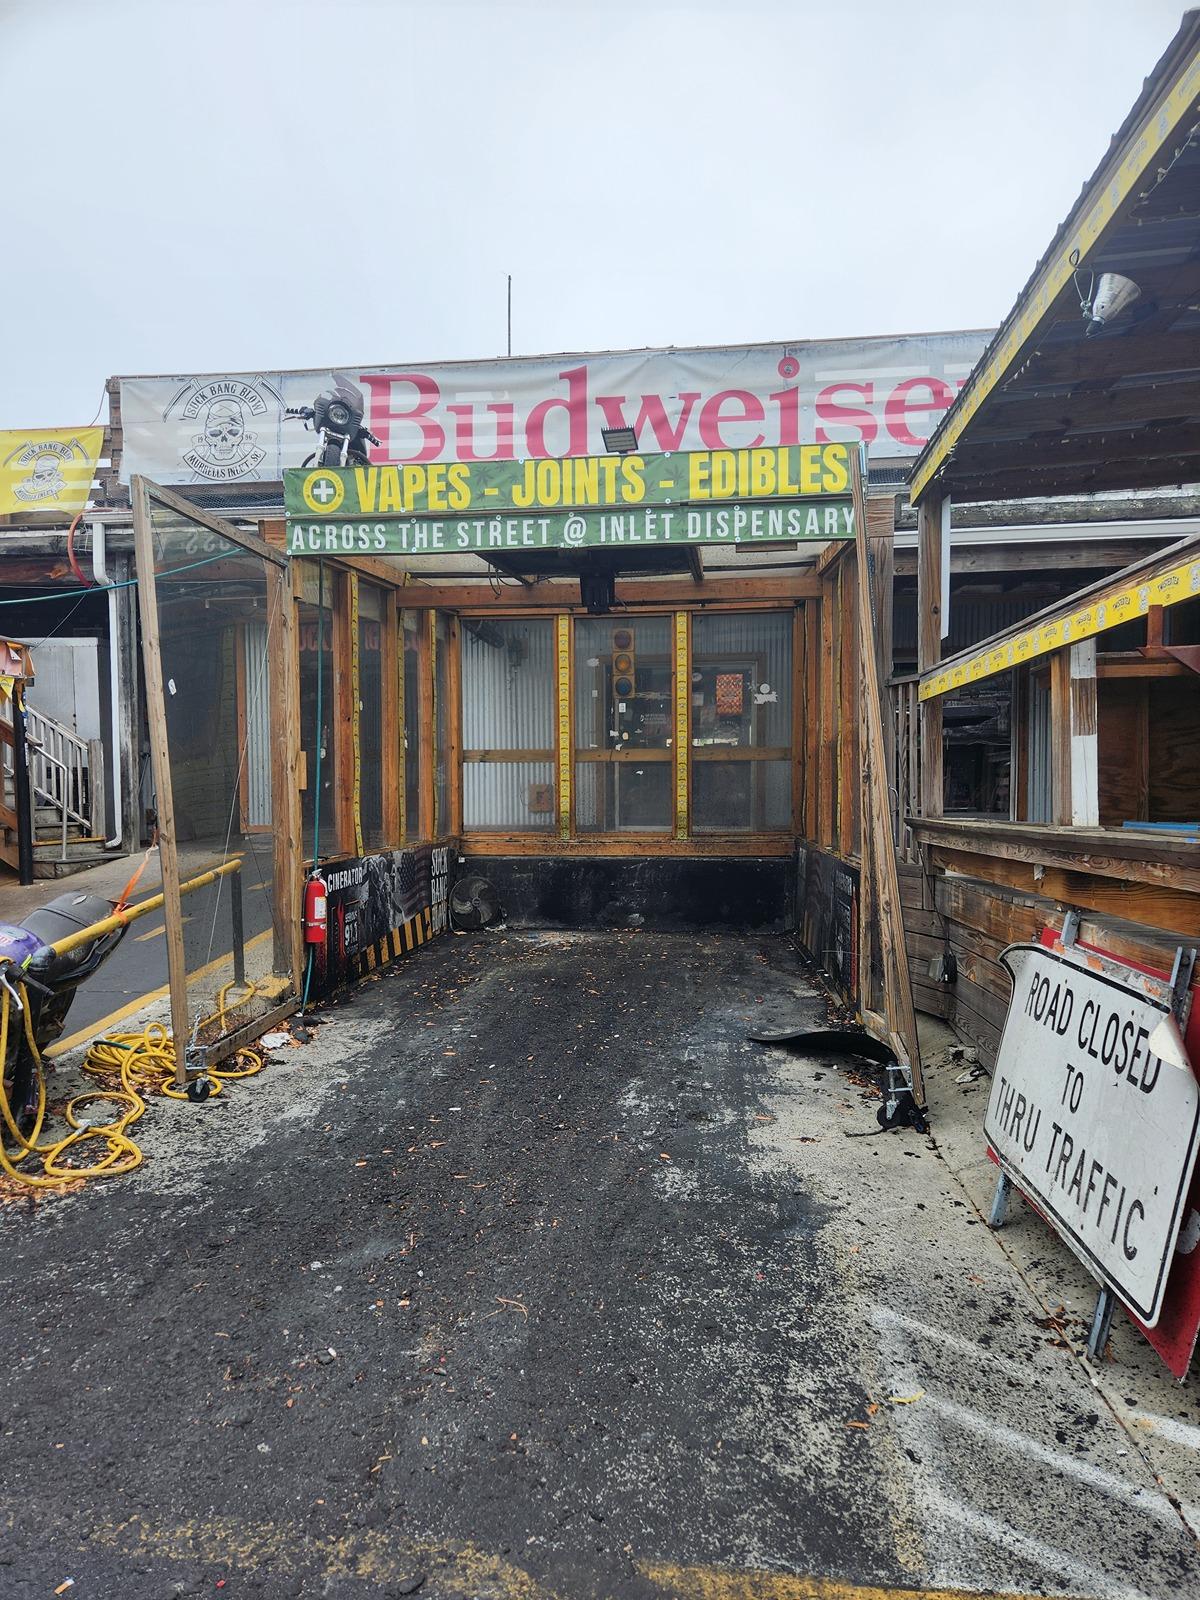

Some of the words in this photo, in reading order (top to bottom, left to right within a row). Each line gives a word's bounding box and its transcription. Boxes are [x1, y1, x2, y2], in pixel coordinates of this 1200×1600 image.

[186, 391, 209, 416] SUCK
[209, 382, 238, 396] BANG
[240, 386, 264, 413] BLOW
[359, 356, 962, 463] Budweise
[187, 454, 226, 478] MURRELLS
[355, 464, 471, 512] VAPES
[512, 456, 645, 507] JOINTS
[689, 444, 848, 499] EDIBLES
[292, 523, 386, 550] ACROSS
[399, 522, 444, 549] THE
[457, 518, 550, 547] STREET
[563, 516, 587, 544] @
[600, 513, 674, 542] INLET
[687, 507, 855, 539] DISPENSARY
[431, 846, 448, 877] SUCK
[1024, 971, 1073, 1037] ROAD
[1077, 999, 1162, 1095] CLOSED
[1061, 1062, 1084, 1115] TO
[994, 1076, 1042, 1153] THRU
[1045, 1121, 1146, 1261] TRAFFIC
